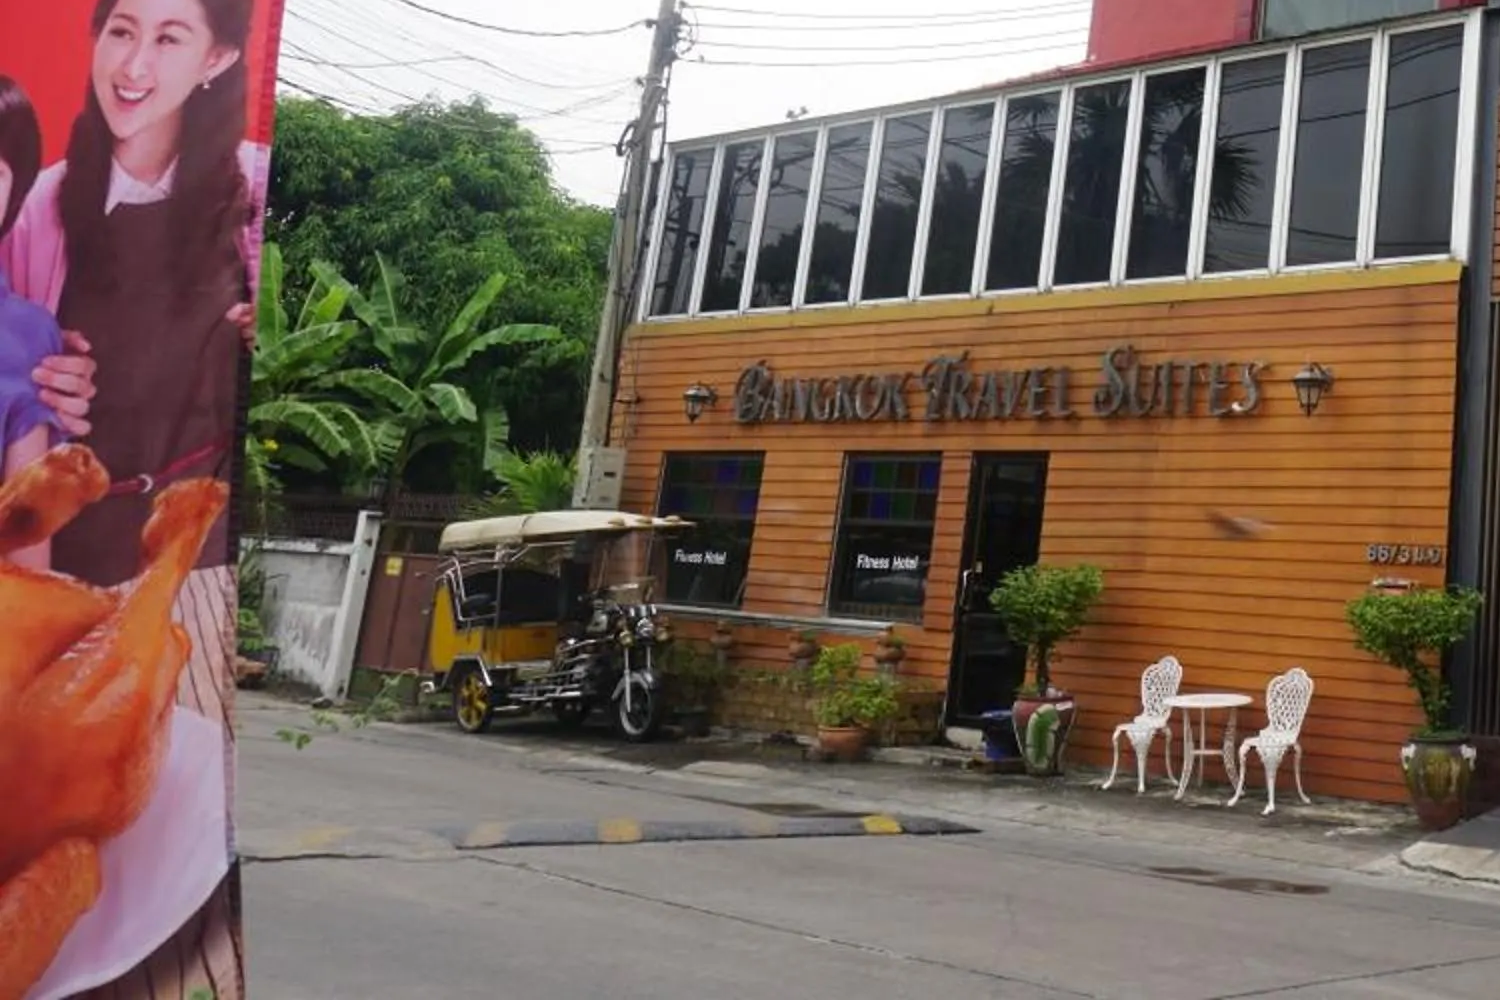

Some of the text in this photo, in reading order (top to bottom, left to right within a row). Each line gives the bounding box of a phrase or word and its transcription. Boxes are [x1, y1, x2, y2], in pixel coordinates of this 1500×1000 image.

[735, 344, 1266, 424] BANGKOK TRAVEL SUITES
[856, 553, 919, 570] Fitness Hotel
